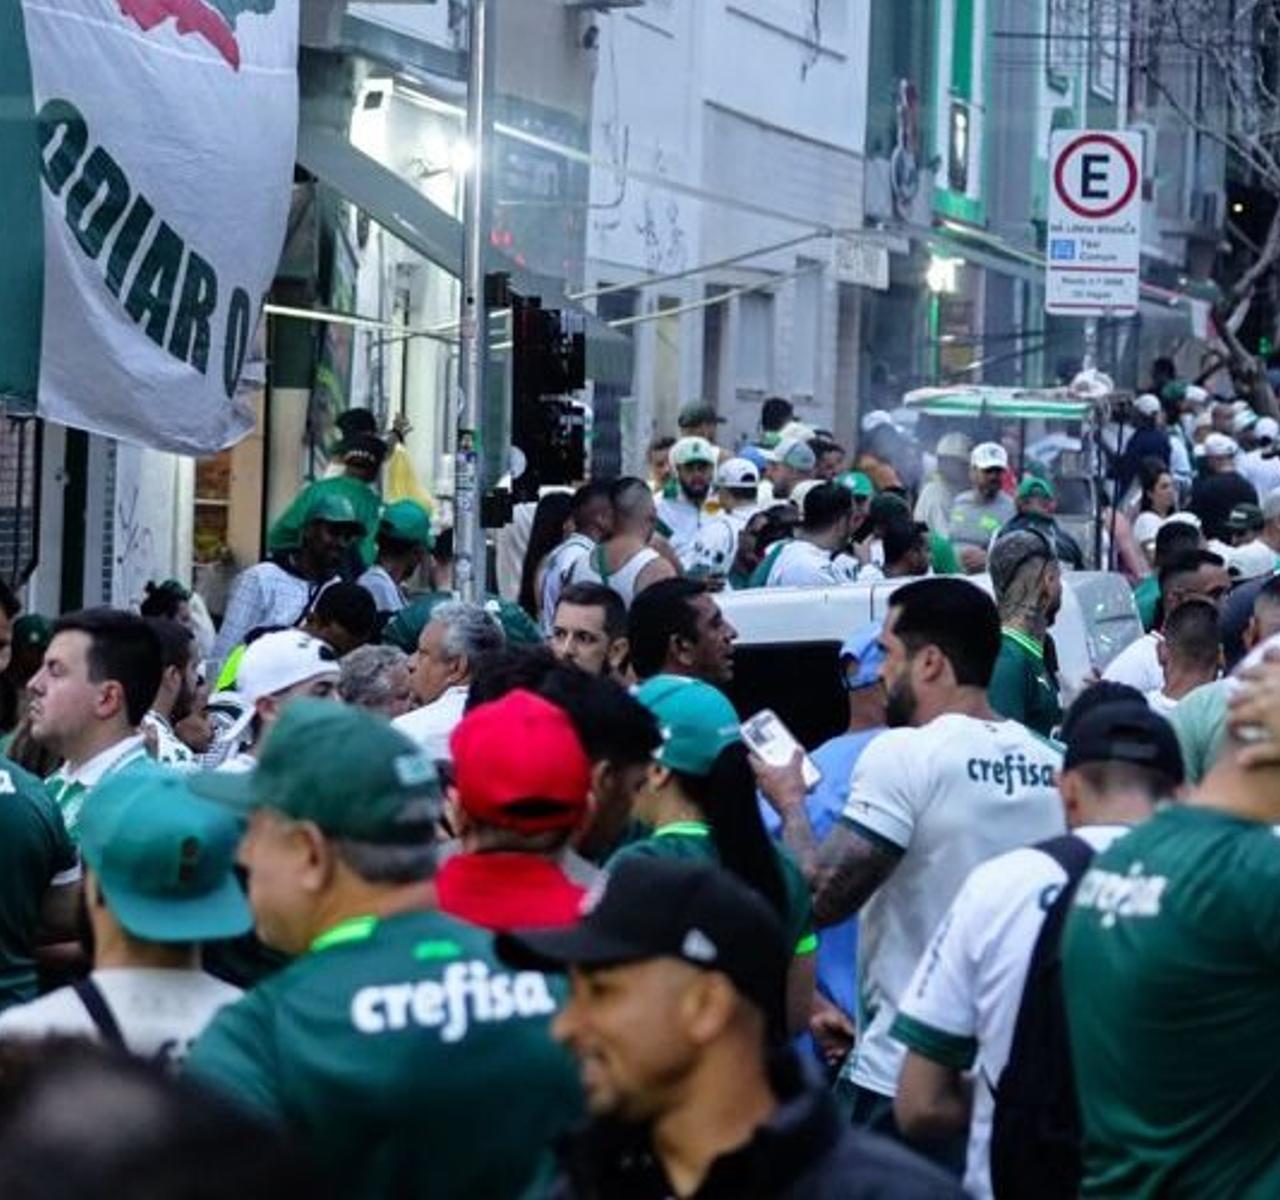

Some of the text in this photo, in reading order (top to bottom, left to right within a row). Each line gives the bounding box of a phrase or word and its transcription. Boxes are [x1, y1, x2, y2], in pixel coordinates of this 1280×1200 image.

[1081, 153, 1110, 200] E
[36, 97, 218, 375] ODIAR
[967, 753, 1056, 796] crefisa
[351, 959, 557, 1044] crefisa
